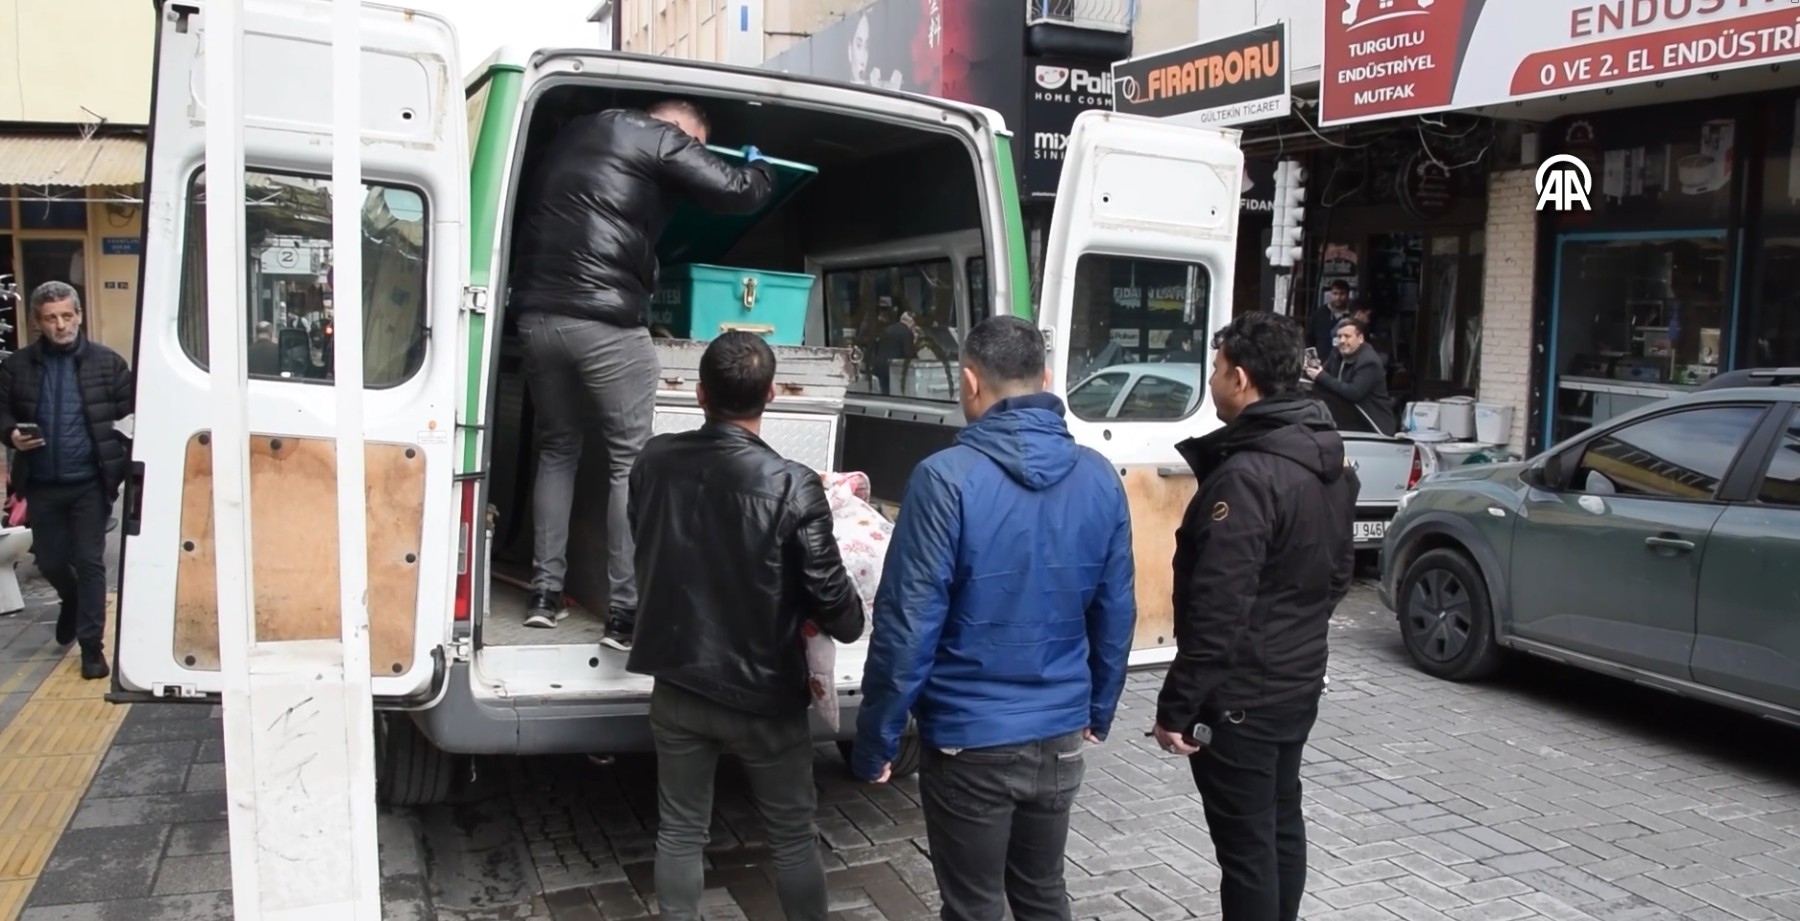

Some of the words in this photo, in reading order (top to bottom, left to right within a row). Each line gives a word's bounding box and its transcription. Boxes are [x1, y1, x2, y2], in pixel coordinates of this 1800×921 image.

[1348, 29, 1425, 58] TURGUTLU
[1148, 40, 1279, 101] FIRATBORU
[1338, 55, 1436, 84] ENDÜSTRİYEL
[1563, 57, 1592, 82] VE
[1599, 53, 1619, 78] 2.
[1627, 49, 1654, 73] EL
[1034, 92, 1071, 103] HOME
[1354, 83, 1415, 106] MUTFAK
[1200, 104, 1240, 123] GÜLTEKİN
[1243, 100, 1280, 115] TİCARET
[281, 251, 294, 262] 2
[1362, 523, 1382, 537] 946
